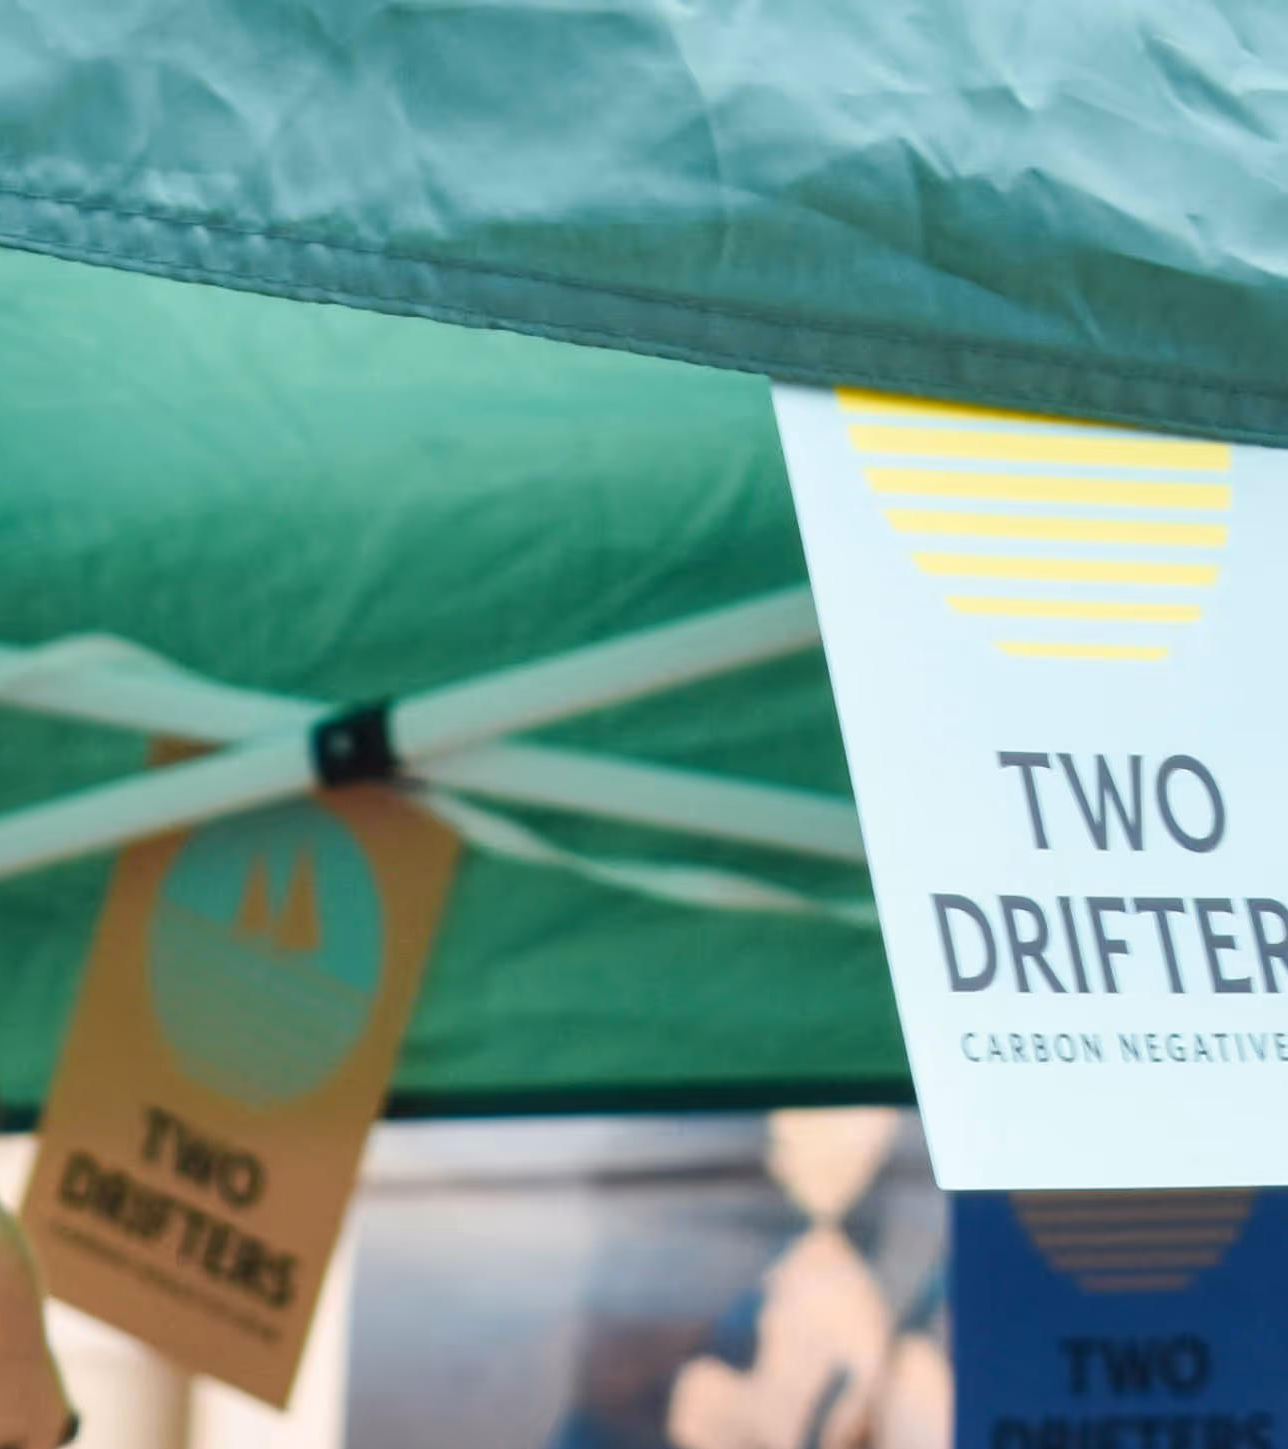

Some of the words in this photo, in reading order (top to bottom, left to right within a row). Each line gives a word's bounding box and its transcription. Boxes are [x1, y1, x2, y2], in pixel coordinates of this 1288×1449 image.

[996, 749, 1227, 853] TWO
[960, 1031, 1104, 1063] CARBON
[1120, 1031, 1288, 1063] NEGATIVE
[138, 1102, 266, 1212] TWO
[55, 1152, 299, 1314] DRIFTERS
[1058, 1333, 1211, 1398] TWO
